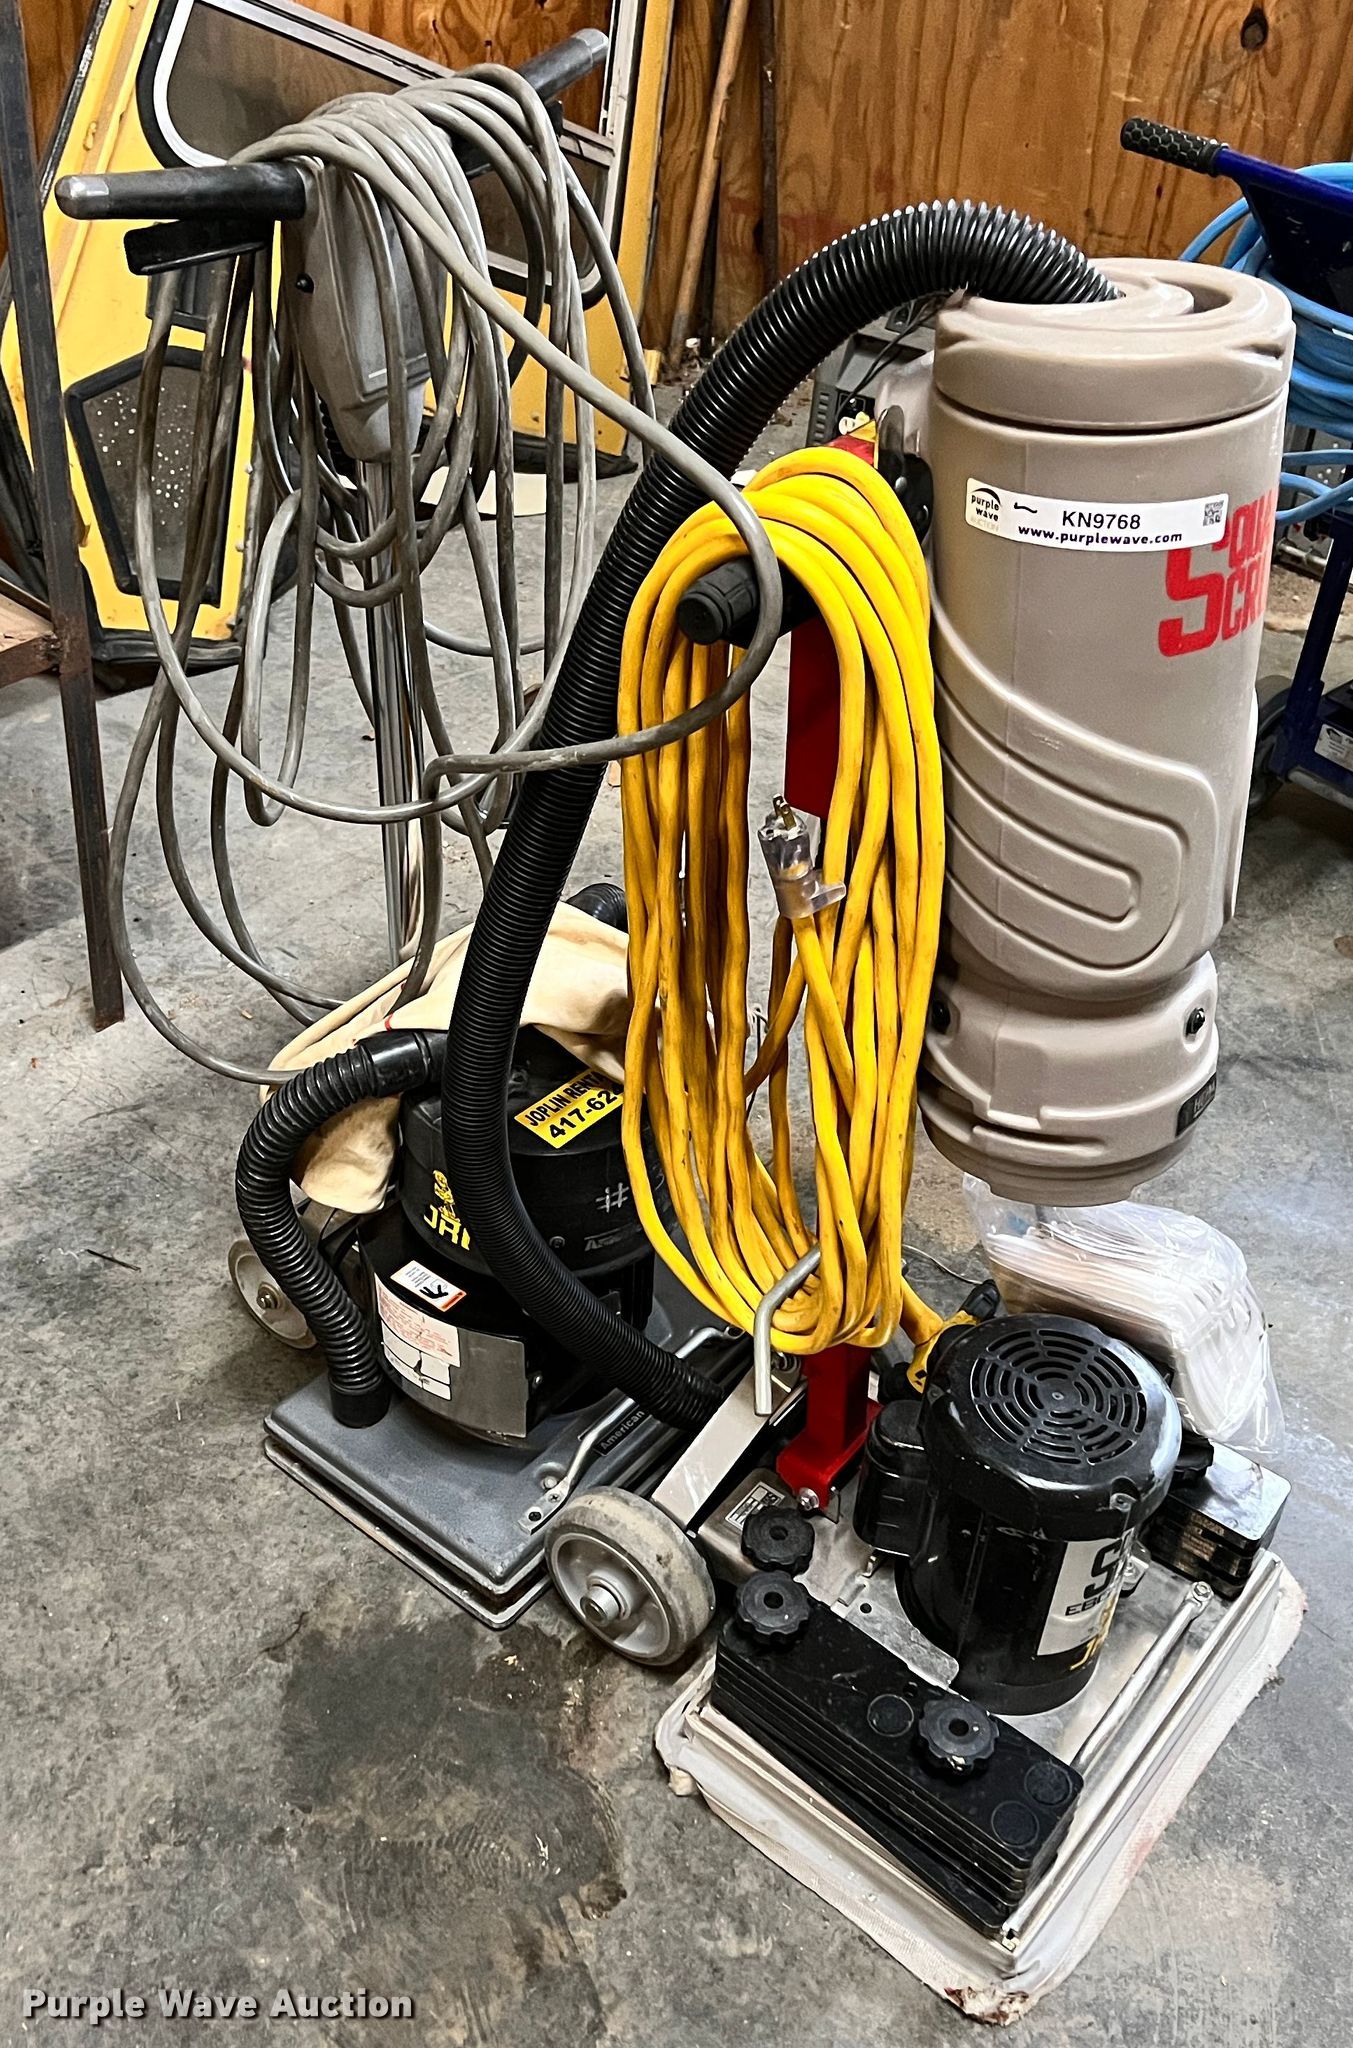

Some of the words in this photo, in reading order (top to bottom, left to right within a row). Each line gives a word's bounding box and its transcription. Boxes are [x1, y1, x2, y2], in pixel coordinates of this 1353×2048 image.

[971, 494, 999, 511] purple
[975, 507, 999, 521] wave
[1062, 510, 1141, 530] KN9768
[1018, 525, 1183, 546] www.purplewave.com
[525, 1094, 571, 1126] JOPLIN
[600, 1410, 645, 1450] American
